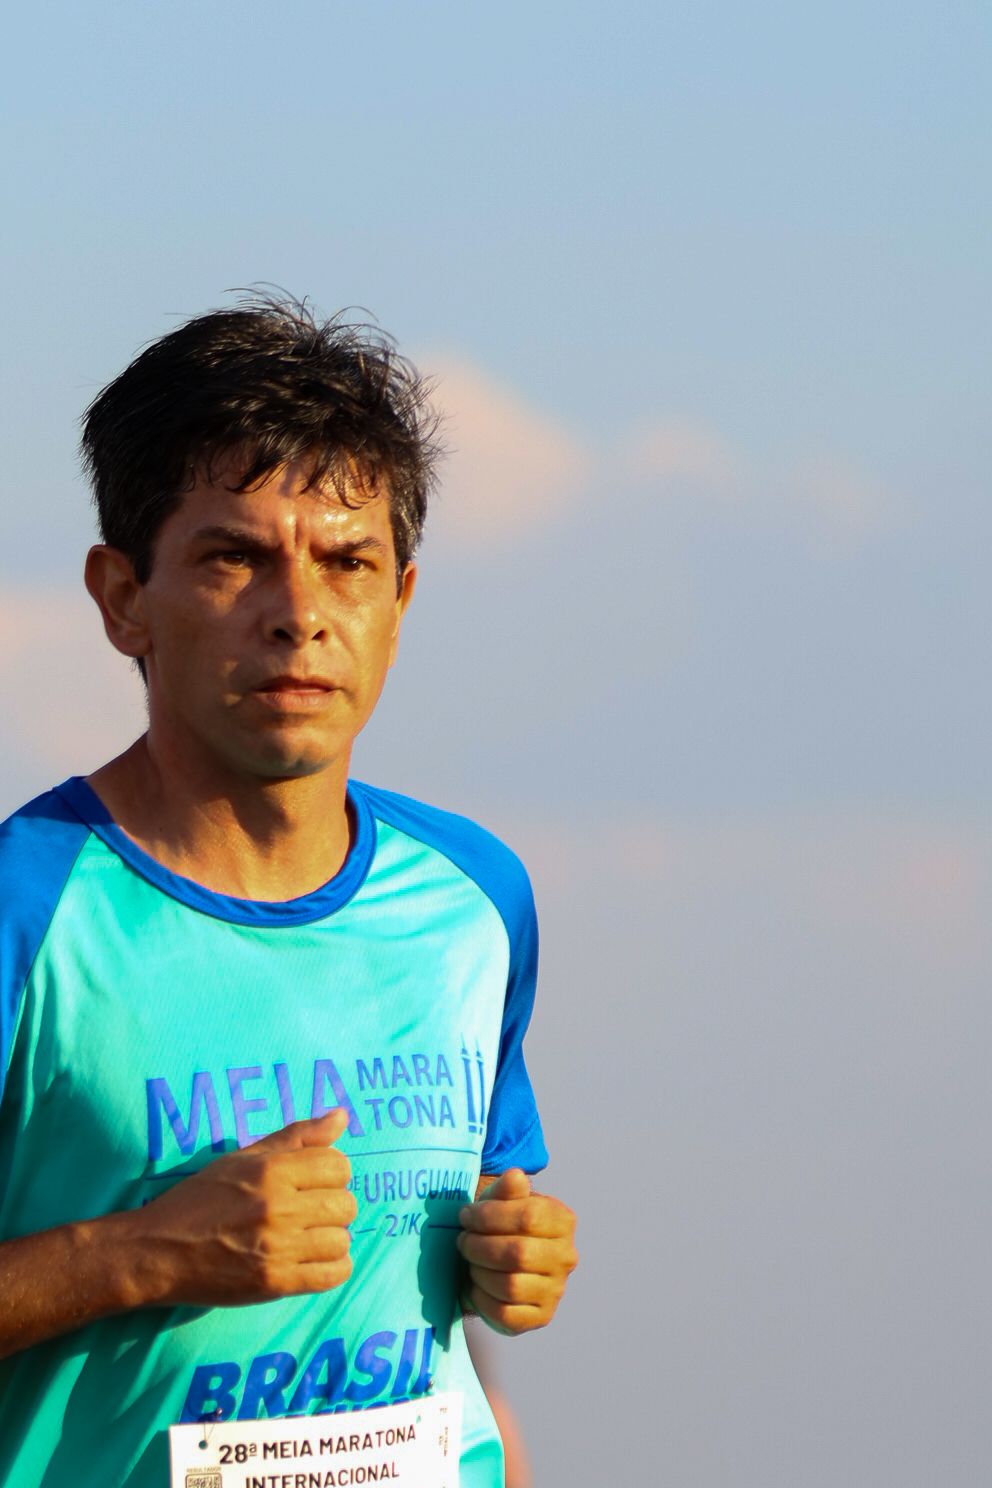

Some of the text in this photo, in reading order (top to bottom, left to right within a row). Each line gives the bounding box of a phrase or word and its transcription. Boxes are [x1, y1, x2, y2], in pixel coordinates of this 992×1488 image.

[356, 1053, 454, 1091] MARA
[146, 1059, 365, 1162] MEIA
[364, 1094, 456, 1131] TONA
[385, 1212, 422, 1237] 21K
[262, 1440, 314, 1460] MEIA
[319, 1424, 417, 1456] MARATONA
